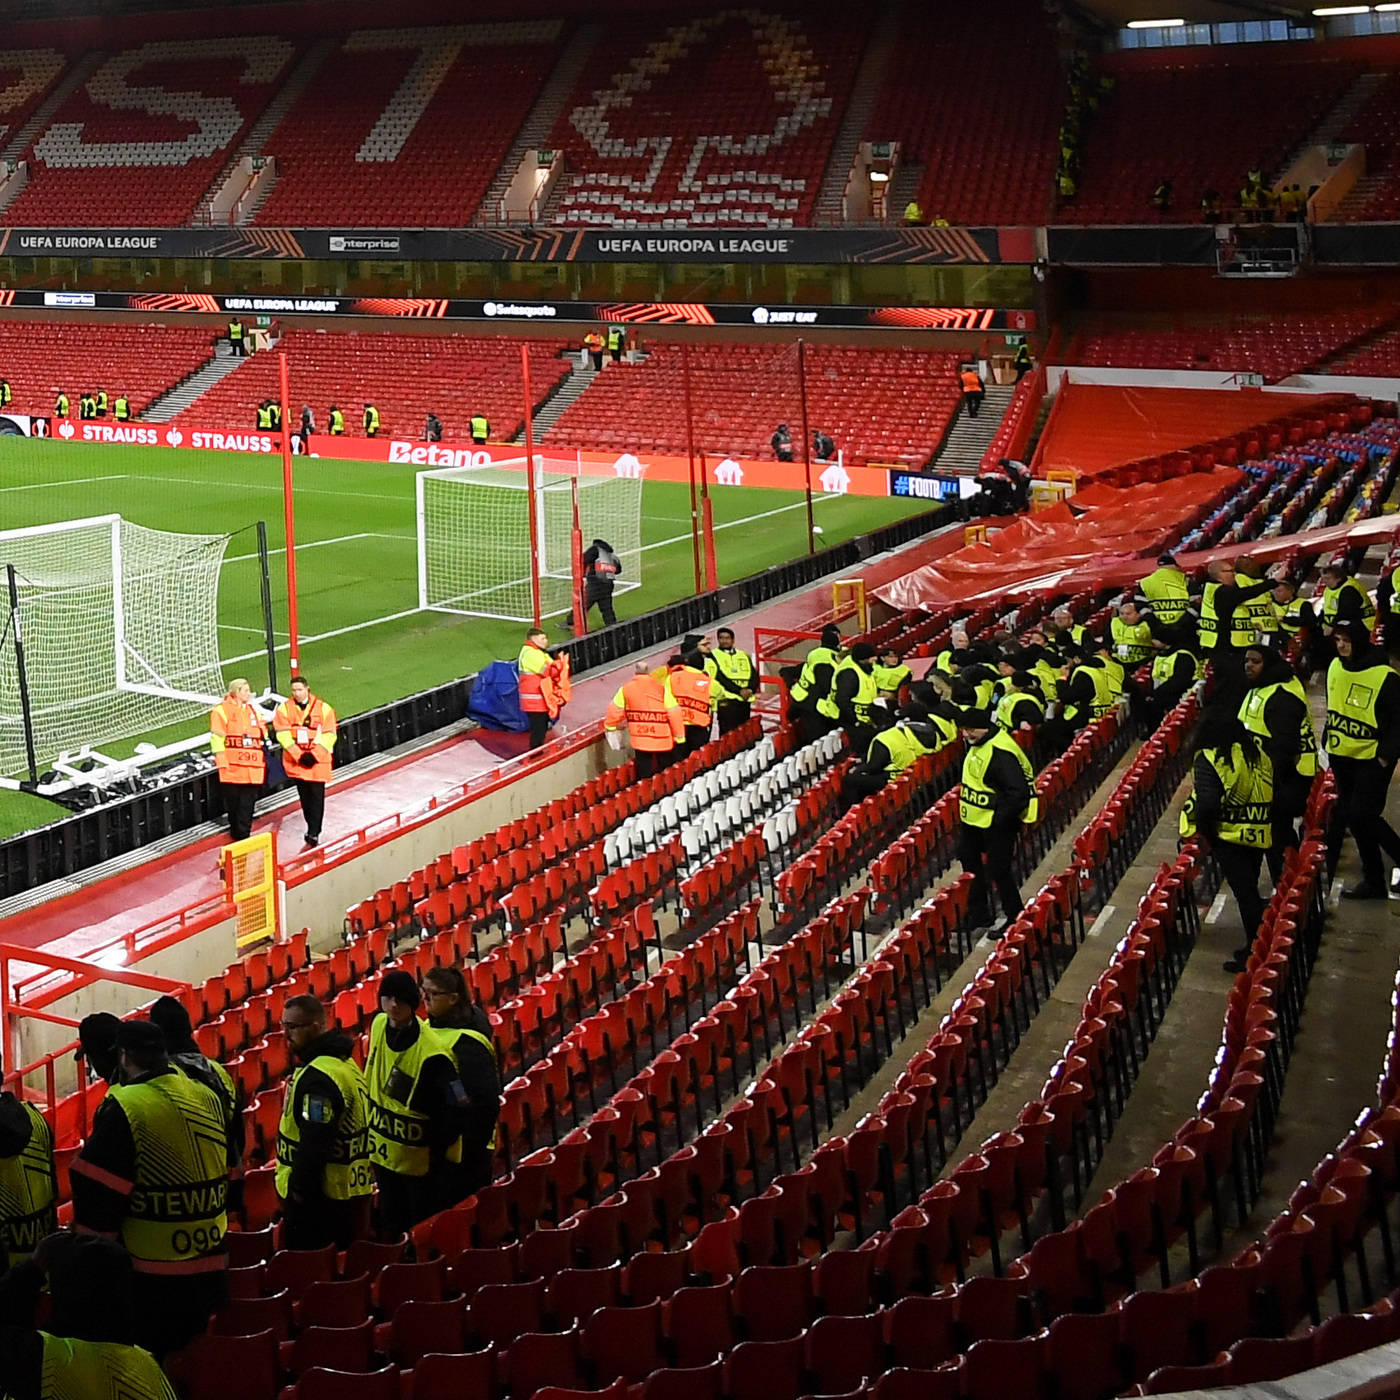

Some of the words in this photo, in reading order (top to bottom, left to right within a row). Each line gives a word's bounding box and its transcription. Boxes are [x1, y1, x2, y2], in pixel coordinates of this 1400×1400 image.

[21, 236, 52, 248] UEFA
[55, 236, 104, 248] EUROPA
[107, 237, 157, 249] LEAGUE
[598, 239, 643, 252] UEFA
[647, 239, 715, 253] EUROPA
[719, 240, 788, 253] LEAGUE
[82, 424, 158, 445] STRAUSS
[191, 432, 272, 453] STRAUSS
[388, 440, 492, 468] Betano
[636, 724, 656, 734] 294
[1327, 712, 1373, 738] WARD
[238, 751, 258, 762] 296
[367, 1105, 423, 1141] WARD
[131, 1181, 229, 1215] STEWAR
